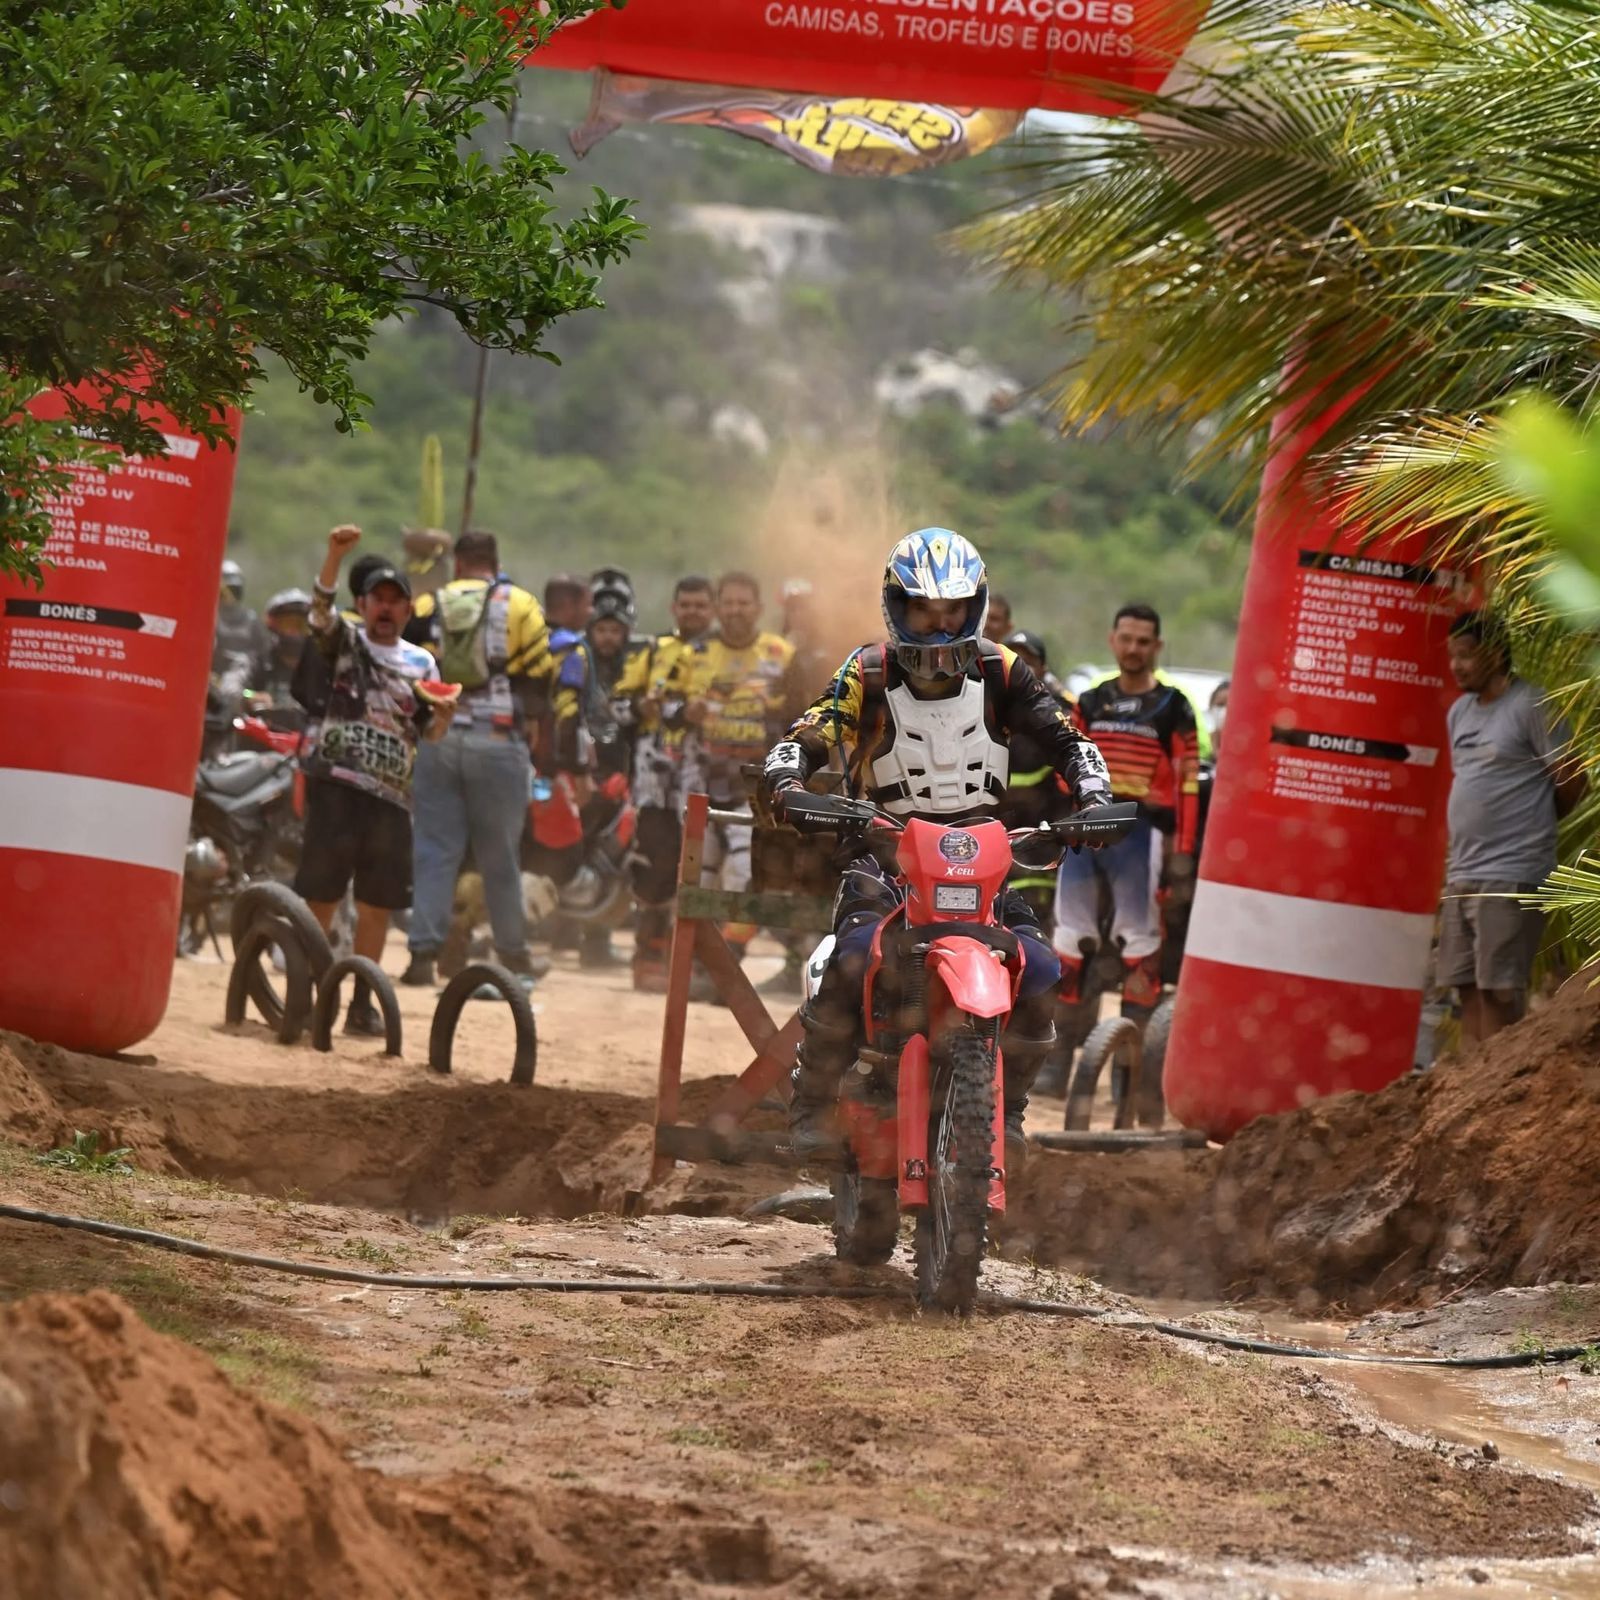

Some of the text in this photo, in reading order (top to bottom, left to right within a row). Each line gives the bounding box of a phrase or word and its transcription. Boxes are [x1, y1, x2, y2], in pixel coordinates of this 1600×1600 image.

[765, 2, 1134, 57] CAMISAS, TROFÉUS E BONÉS
[128, 466, 192, 487] FUTEBOL
[112, 489, 134, 501] UV
[81, 521, 102, 533] DE
[106, 524, 150, 540] MOTO
[80, 532, 100, 544] DE
[104, 536, 180, 557] BICICLETA
[1304, 573, 1415, 598] FARDAMENTOS
[40, 603, 97, 621] BONÉS
[1301, 599, 1378, 618] CICLISTAS
[1375, 596, 1396, 608] DE
[1297, 623, 1357, 640] EVENTO
[1299, 610, 1405, 635] PROTEÇÃO UV
[12, 628, 124, 649] EMBORRACHADOS
[9, 650, 75, 664] BORDADOS
[11, 639, 126, 660] ALTO RELEVO E 3D
[1352, 654, 1373, 666] DE
[1377, 657, 1418, 673] MOTO
[8, 660, 166, 690] PROMOCIONAIS (PINTADO)
[1290, 670, 1345, 686] EQUIPE
[1350, 665, 1370, 677] DE
[1374, 668, 1444, 688] BICICLETA
[1289, 682, 1377, 704] CAVALGADA
[1308, 733, 1366, 754] BONÉS
[1276, 766, 1308, 780] ALTO
[1311, 772, 1361, 787] RELEVO
[1364, 779, 1373, 789] E
[1278, 756, 1391, 779] EMBORRACHADOS
[1275, 777, 1344, 796] BORDADOS
[1273, 787, 1370, 809] PROMOCIONAIS
